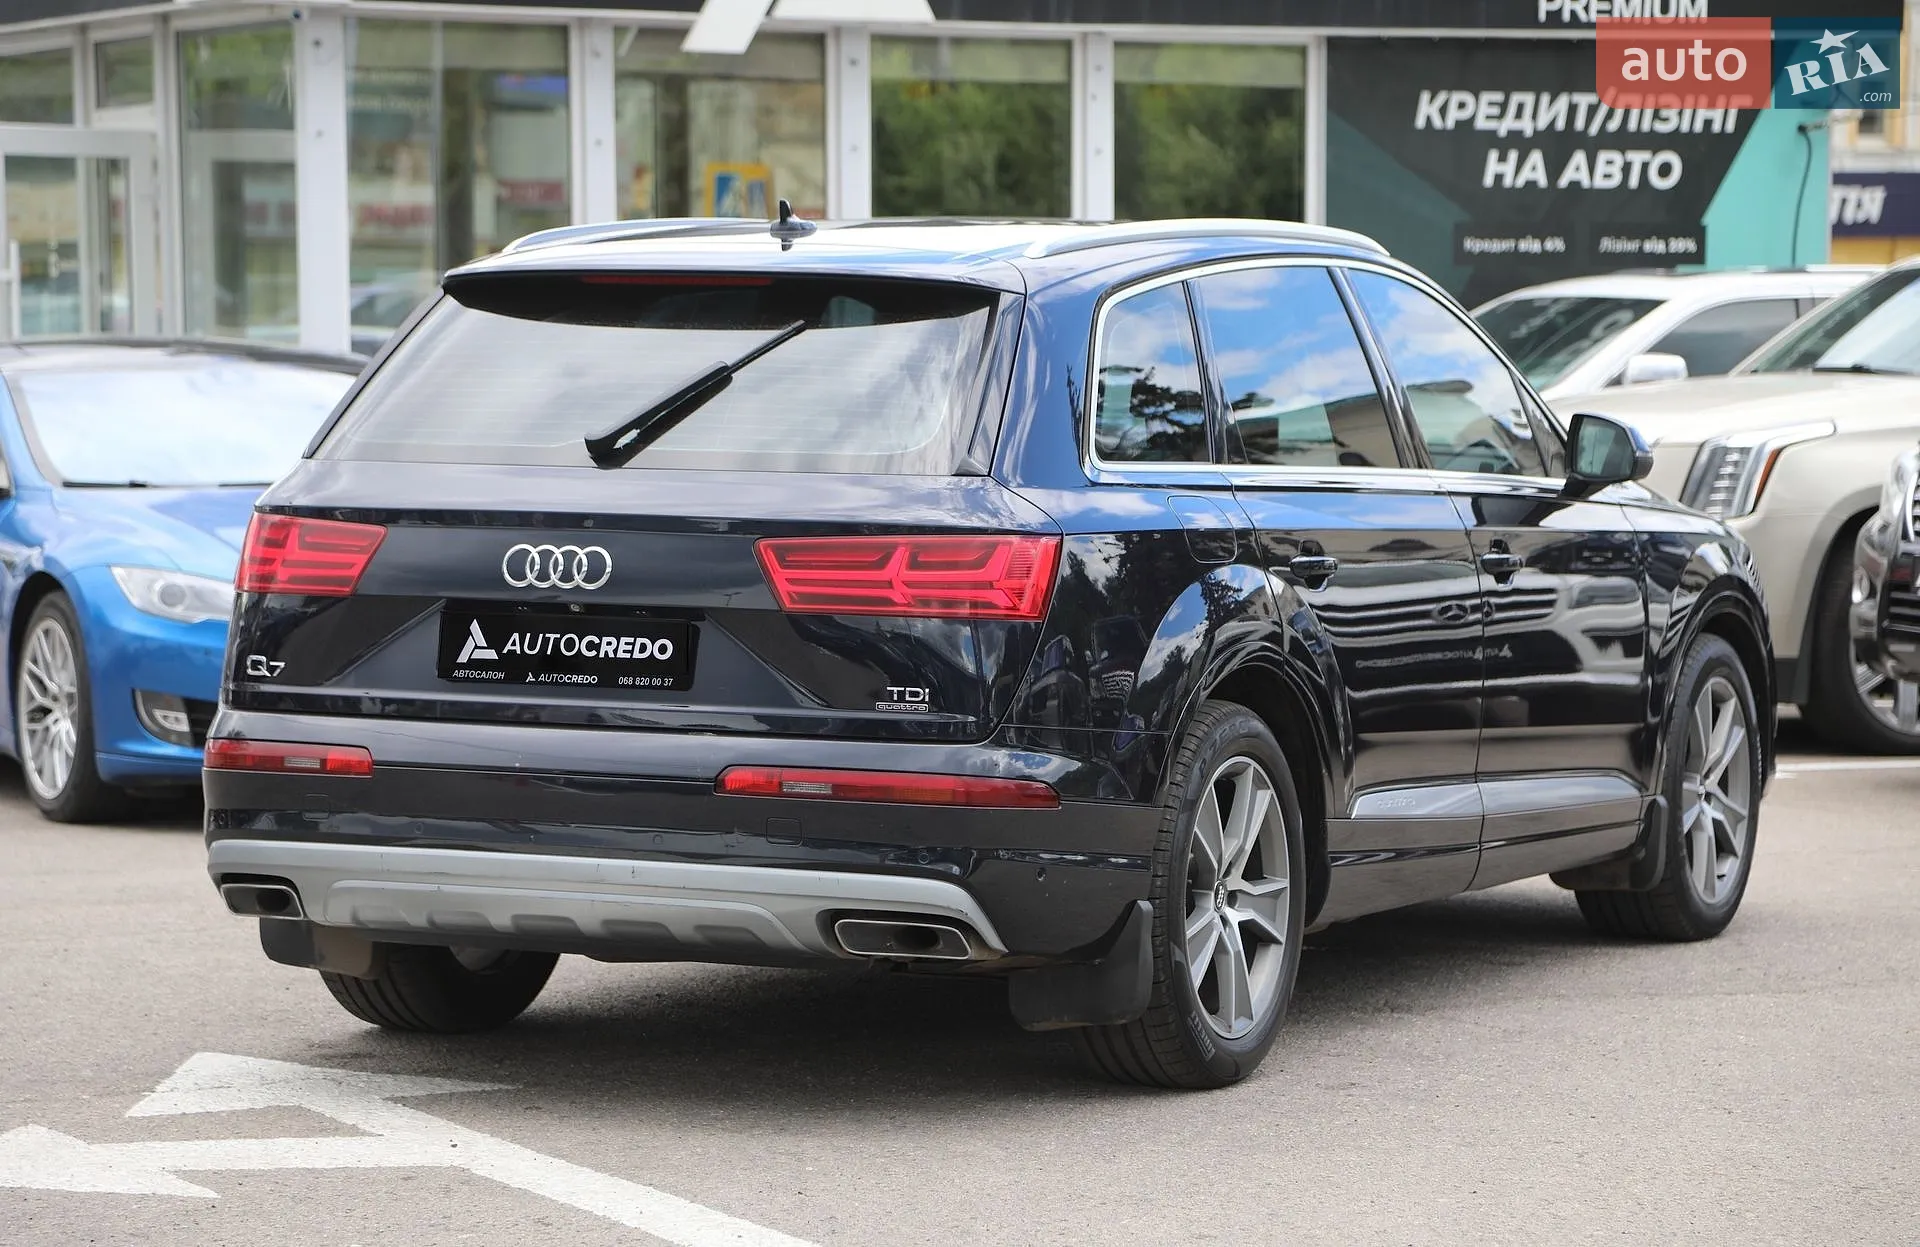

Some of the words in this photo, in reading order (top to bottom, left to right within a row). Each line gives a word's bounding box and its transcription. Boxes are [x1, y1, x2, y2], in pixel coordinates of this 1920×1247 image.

[1537, 0, 1708, 24] PREMIUM
[1482, 148, 1549, 189] НА
[1557, 148, 1683, 190] АВТО
[1463, 235, 1516, 255] Кредит
[502, 632, 674, 661] AUTOCREDO
[246, 655, 286, 677] Q7
[452, 669, 505, 680] АВТОСАЛОН
[538, 673, 598, 685] AUTOCREDO
[618, 676, 634, 685] 068
[635, 677, 650, 686] 820
[651, 677, 662, 686] 00
[663, 678, 674, 686] 37
[886, 686, 930, 702] TDI
[876, 702, 928, 712] quattro
